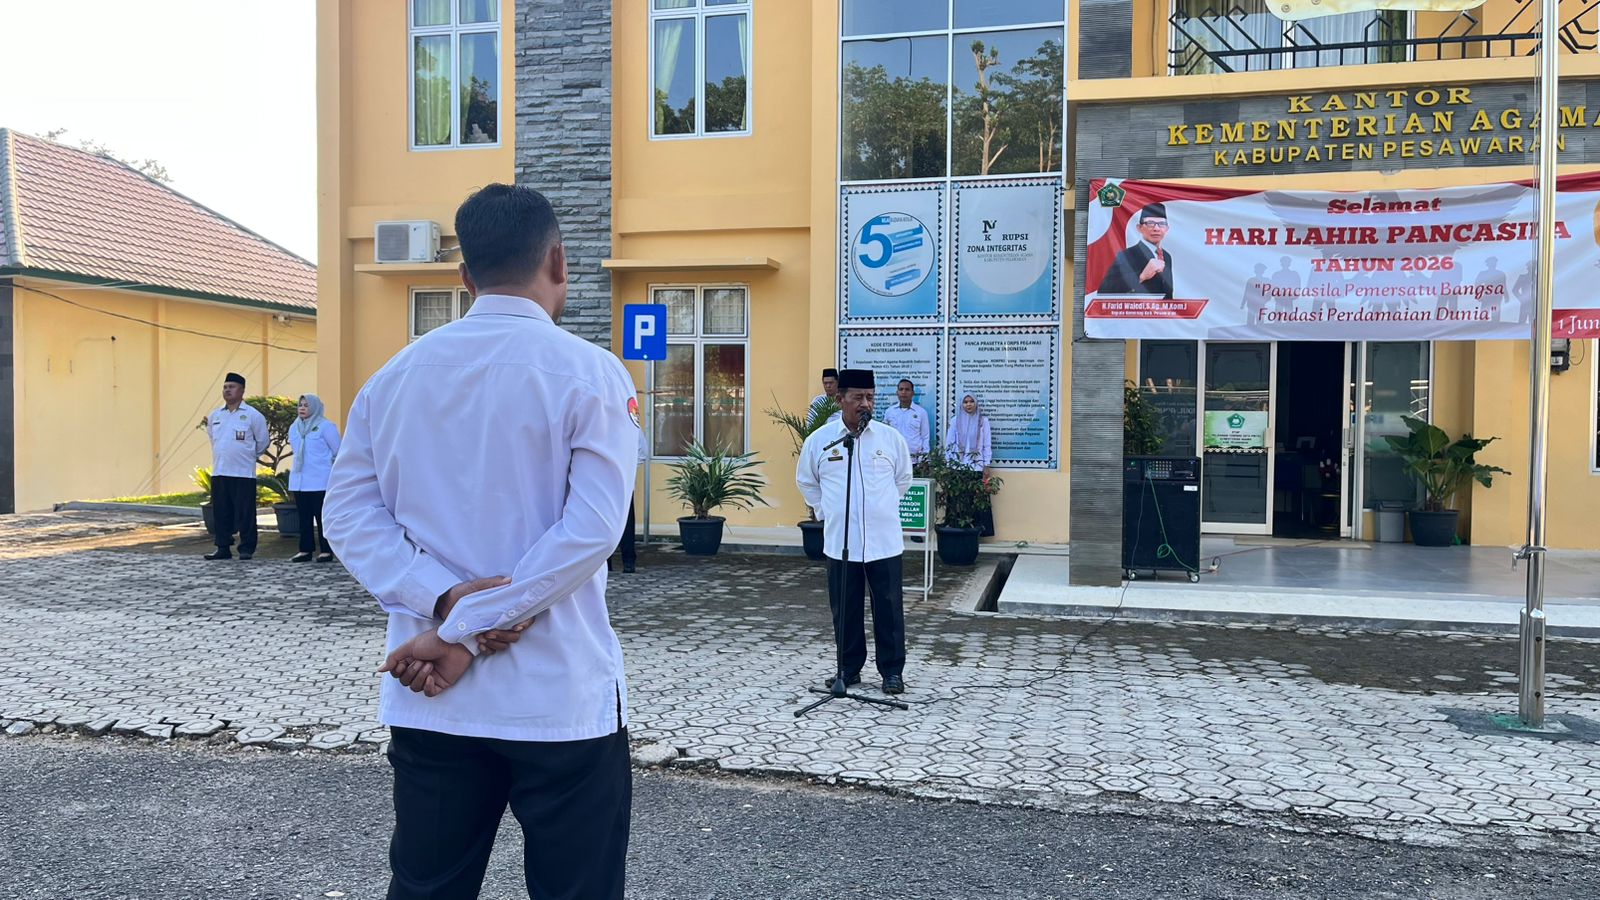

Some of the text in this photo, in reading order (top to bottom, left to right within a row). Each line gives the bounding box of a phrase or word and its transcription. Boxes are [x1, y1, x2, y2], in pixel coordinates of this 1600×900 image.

[1287, 87, 1473, 114] KANTOR
[1167, 105, 1600, 146] KEMENTERIAN AGM
[1213, 143, 1373, 167] KABUPATEN
[1326, 196, 1442, 215] Selamat
[858, 215, 893, 269] 5
[1001, 232, 1029, 241] RUPSI
[1203, 227, 1278, 246] HARI
[1284, 226, 1379, 246] LAHIR
[967, 243, 1028, 253] ZONA INTEGRITAS
[1310, 256, 1454, 273] TAHUN 2026
[1254, 281, 1505, 300] "Pancasila Pemersatu Bangsa
[1257, 305, 1498, 323] Fondasi Perdamaian Dunia"
[634, 314, 656, 350] P
[1557, 318, 1565, 330] 1
